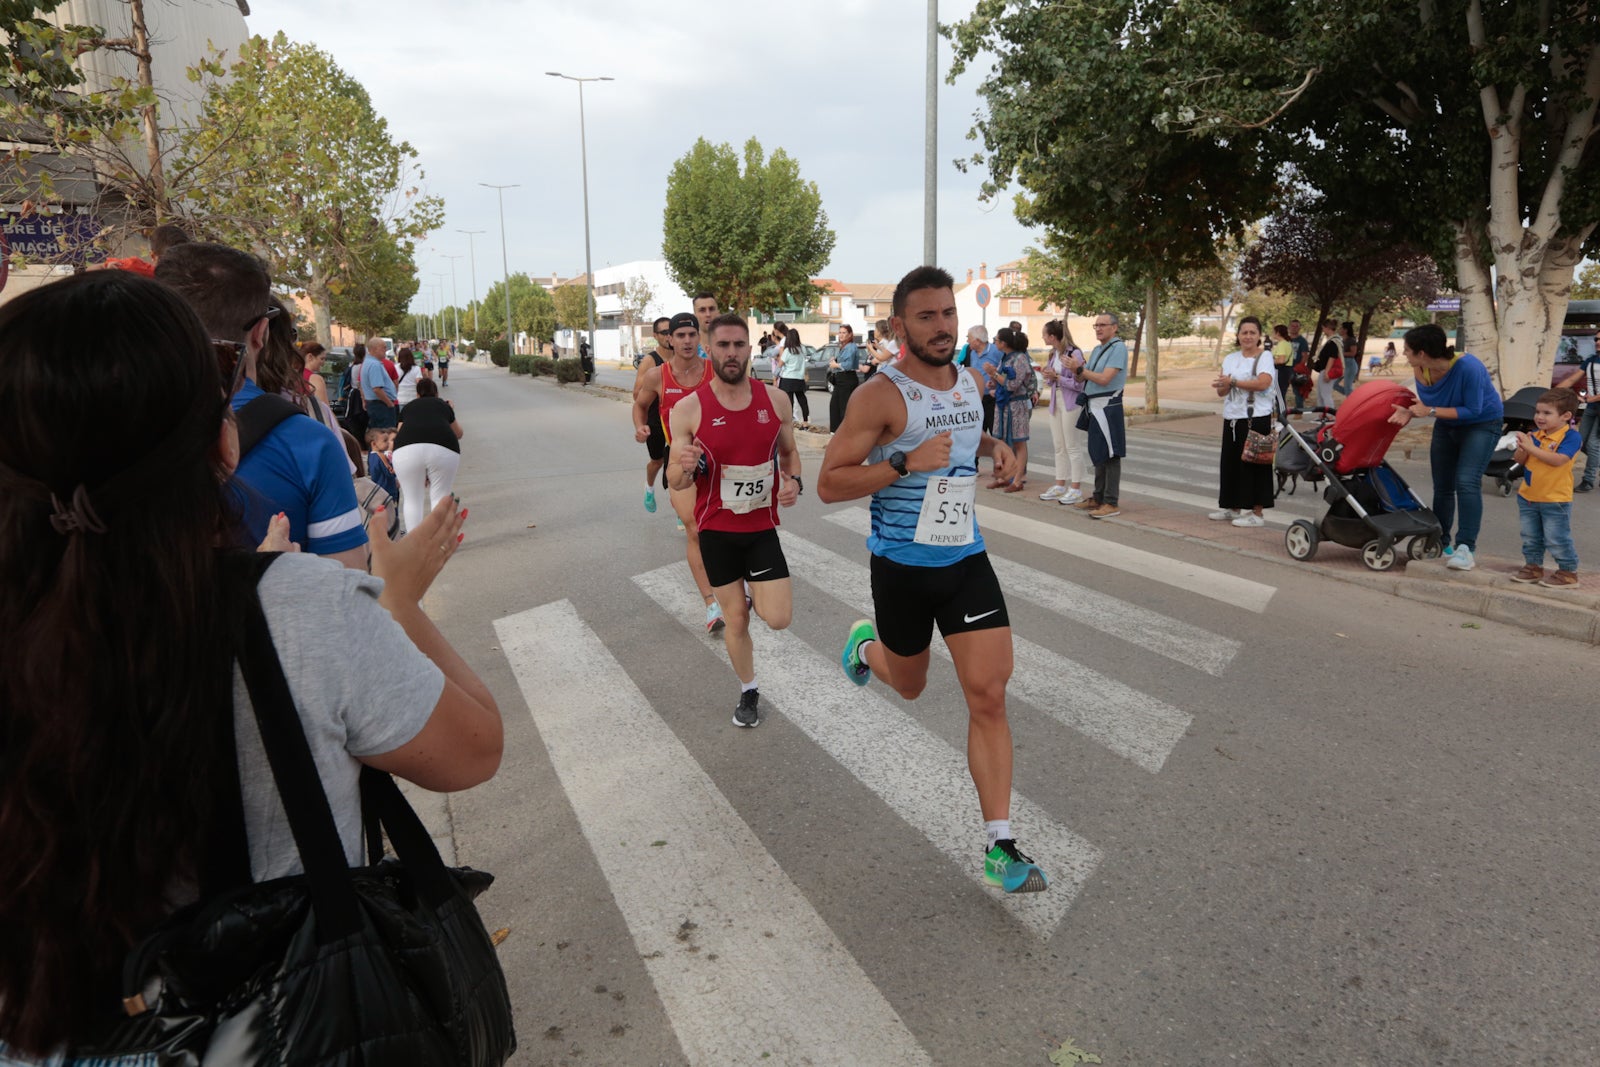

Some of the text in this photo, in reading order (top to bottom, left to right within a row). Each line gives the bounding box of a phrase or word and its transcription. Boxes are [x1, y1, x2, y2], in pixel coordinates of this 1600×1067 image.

[41, 225, 62, 235] DE
[926, 410, 980, 429] MARACENA
[734, 480, 764, 496] 735
[935, 501, 970, 525] 554
